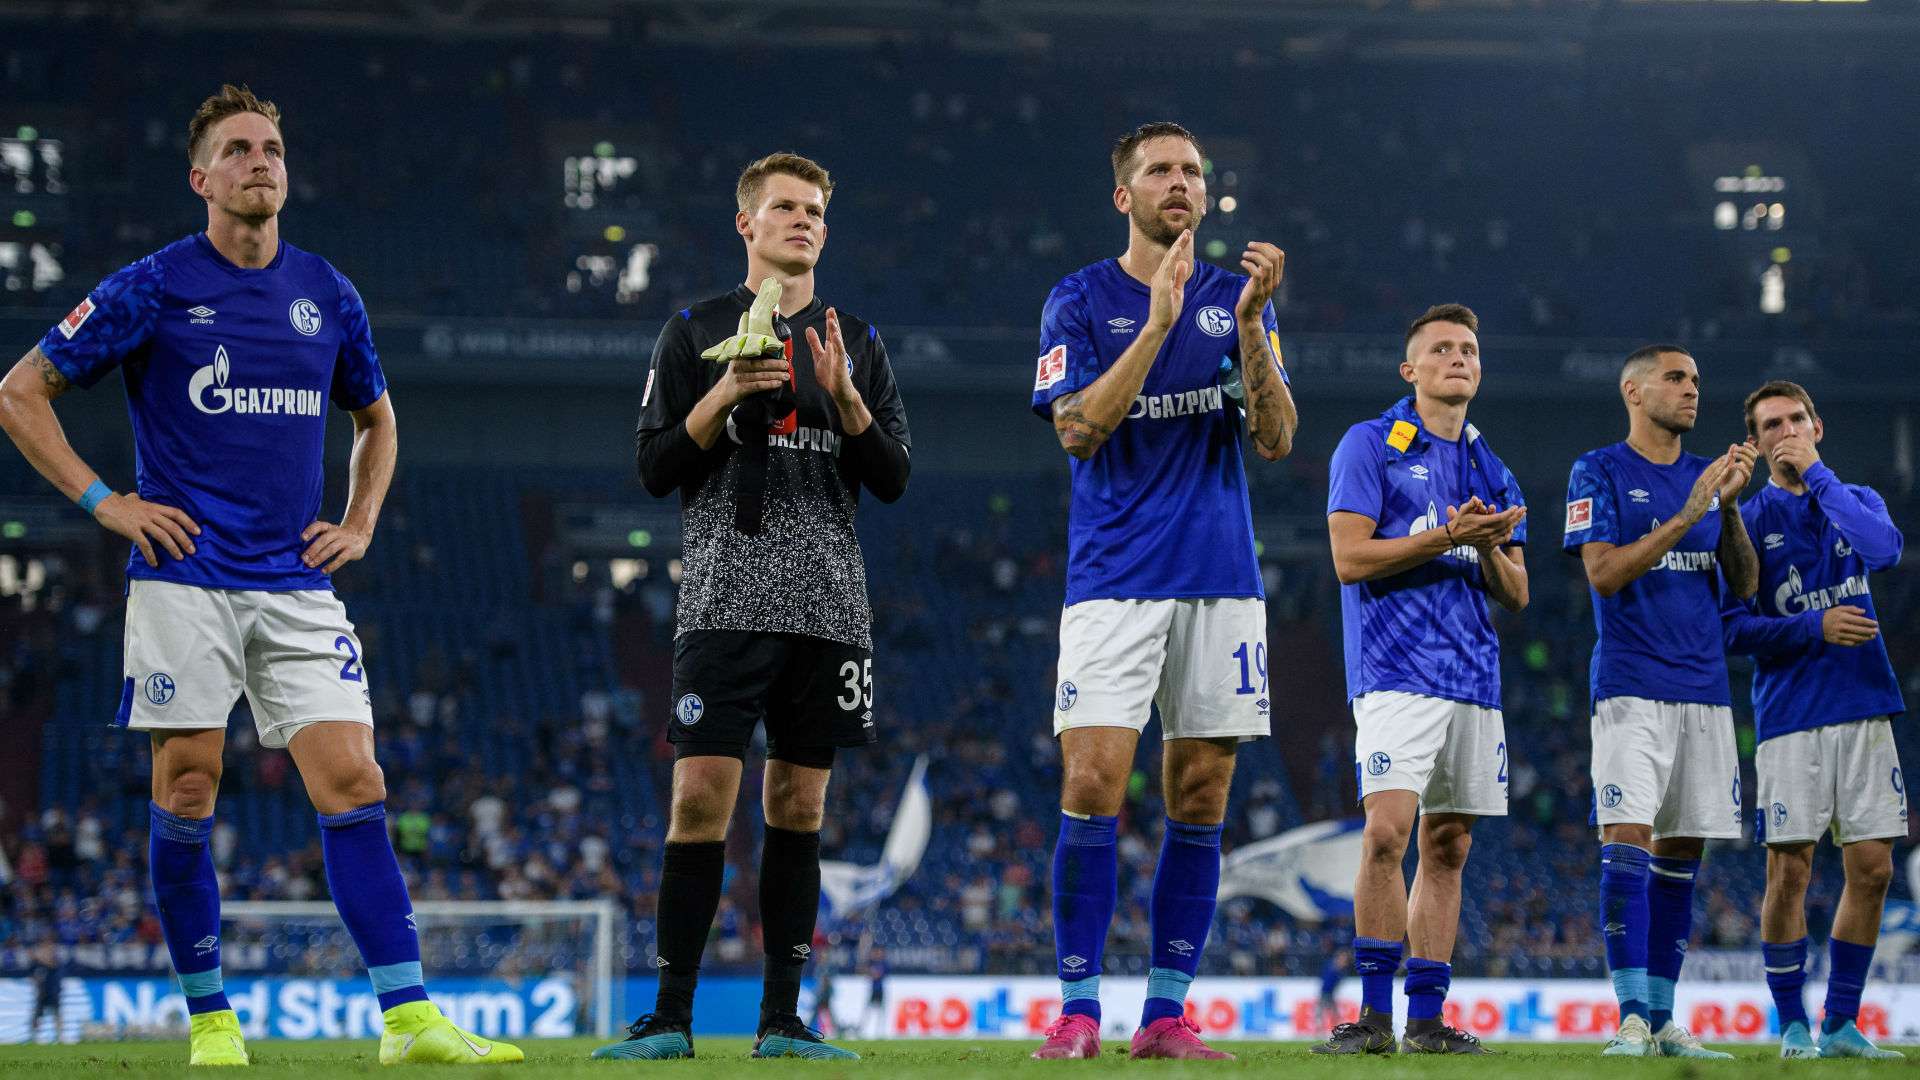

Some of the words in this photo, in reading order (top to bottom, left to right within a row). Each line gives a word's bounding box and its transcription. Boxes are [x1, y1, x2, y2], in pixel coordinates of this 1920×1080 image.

[190, 317, 214, 325] umbro
[235, 387, 321, 417] GAZPROM
[1147, 384, 1223, 419] GAZPRO
[334, 635, 362, 683] 2
[1232, 641, 1268, 695] 19
[837, 658, 873, 711] 35
[1497, 742, 1508, 783] 2
[103, 979, 271, 1041] Nod
[530, 975, 577, 1039] 2
[895, 986, 1062, 1036] ROLLE
